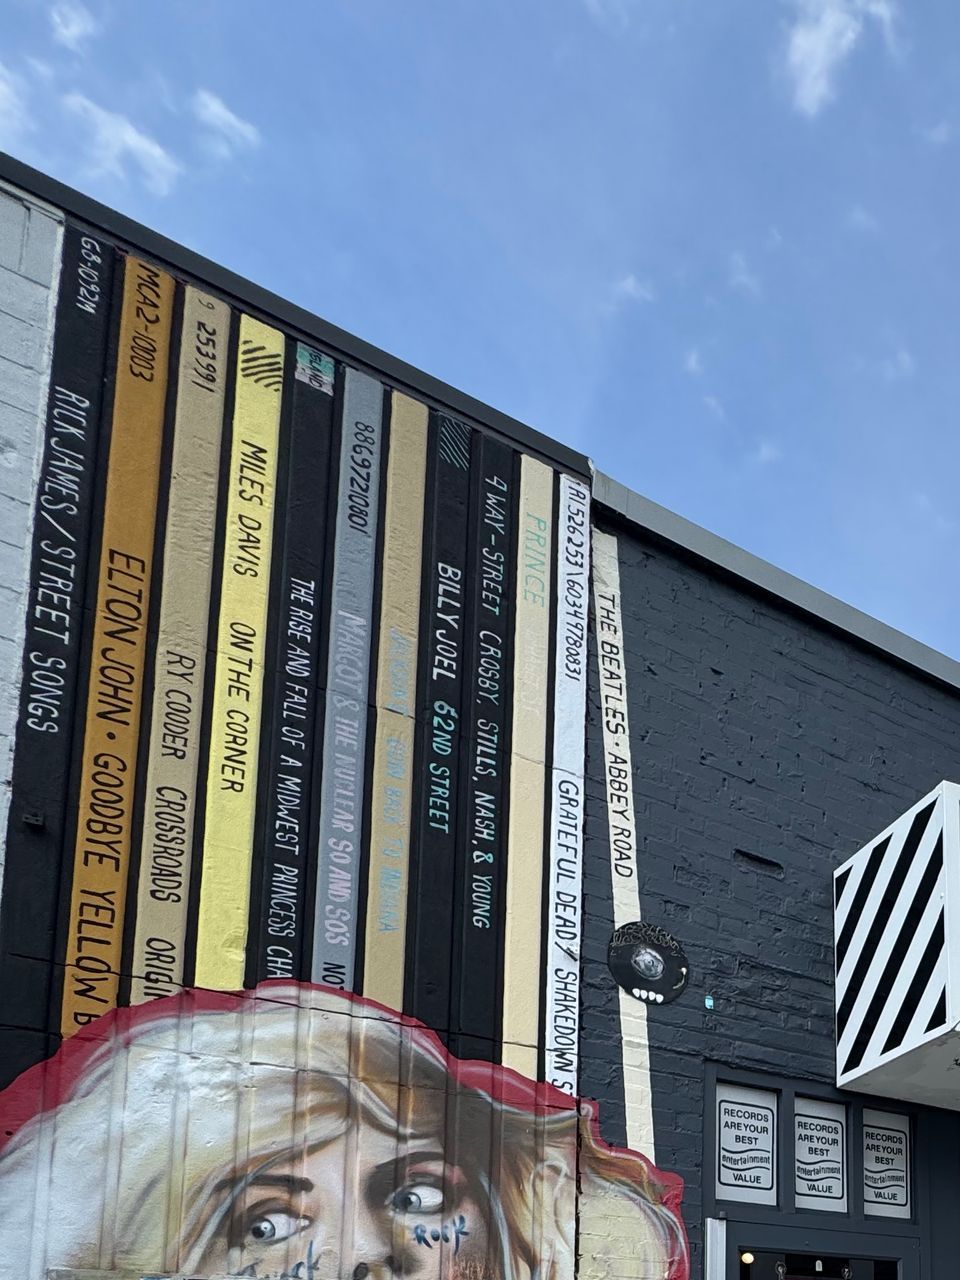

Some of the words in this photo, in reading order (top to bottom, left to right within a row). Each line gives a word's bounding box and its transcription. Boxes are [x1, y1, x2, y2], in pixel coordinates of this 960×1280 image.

[129, 262, 162, 383] MCA2-10003
[190, 321, 217, 394] 253991
[51, 386, 91, 441] RICK
[40, 438, 85, 516] JAMES
[239, 439, 268, 507] MILES
[233, 513, 264, 579] DAVIS
[523, 511, 548, 609] PRINCE
[33, 540, 77, 645] STREET
[104, 548, 146, 646] ELTON
[289, 576, 315, 604] THE
[436, 562, 461, 629] BILLY
[598, 592, 618, 636] THE
[230, 621, 256, 649] ON
[288, 604, 313, 644] RISE
[335, 609, 368, 694] MARGOT
[166, 650, 197, 685] RY
[228, 655, 255, 704] THE
[285, 647, 310, 679] AND
[432, 626, 459, 681] JOEL
[27, 651, 67, 734] SONGS
[96, 647, 136, 726] JOHN
[282, 681, 308, 720] FALL
[600, 640, 627, 737] BEATLES
[161, 689, 192, 761] COODER
[221, 708, 249, 794] CORNER
[281, 723, 305, 751] OF
[334, 716, 360, 748] THE
[84, 751, 128, 873] GOODBYE
[275, 770, 303, 857] MIDWEST
[331, 752, 356, 833] NUCLEAR
[428, 762, 451, 834] STREET
[608, 751, 631, 823] ABBEY
[150, 786, 187, 905] CROSSROADS
[554, 778, 579, 885] GRATEFUL
[611, 823, 633, 880] ROAD
[267, 863, 299, 939] PRINCESS
[328, 865, 352, 903] AND
[470, 872, 494, 930] YOUNG
[73, 888, 116, 1004] YELLOW
[550, 967, 579, 1074] SHAKEDOWN
[723, 1107, 769, 1123] RECORDS
[734, 1134, 759, 1146] BEST
[743, 1122, 770, 1136] YOUR
[797, 1121, 839, 1135] RECORDS
[815, 1135, 839, 1147] YOUR
[865, 1131, 904, 1145] RECORDS
[721, 1153, 771, 1166] entertainment
[796, 1165, 841, 1177] entertainment
[807, 1146, 830, 1157] BEST
[874, 1155, 896, 1166] BEST
[881, 1144, 904, 1156] YOUR
[732, 1172, 762, 1184] VALUE
[806, 1183, 834, 1194] VALUE
[864, 1172, 905, 1184] entertainment
[873, 1190, 898, 1201] VALUE
